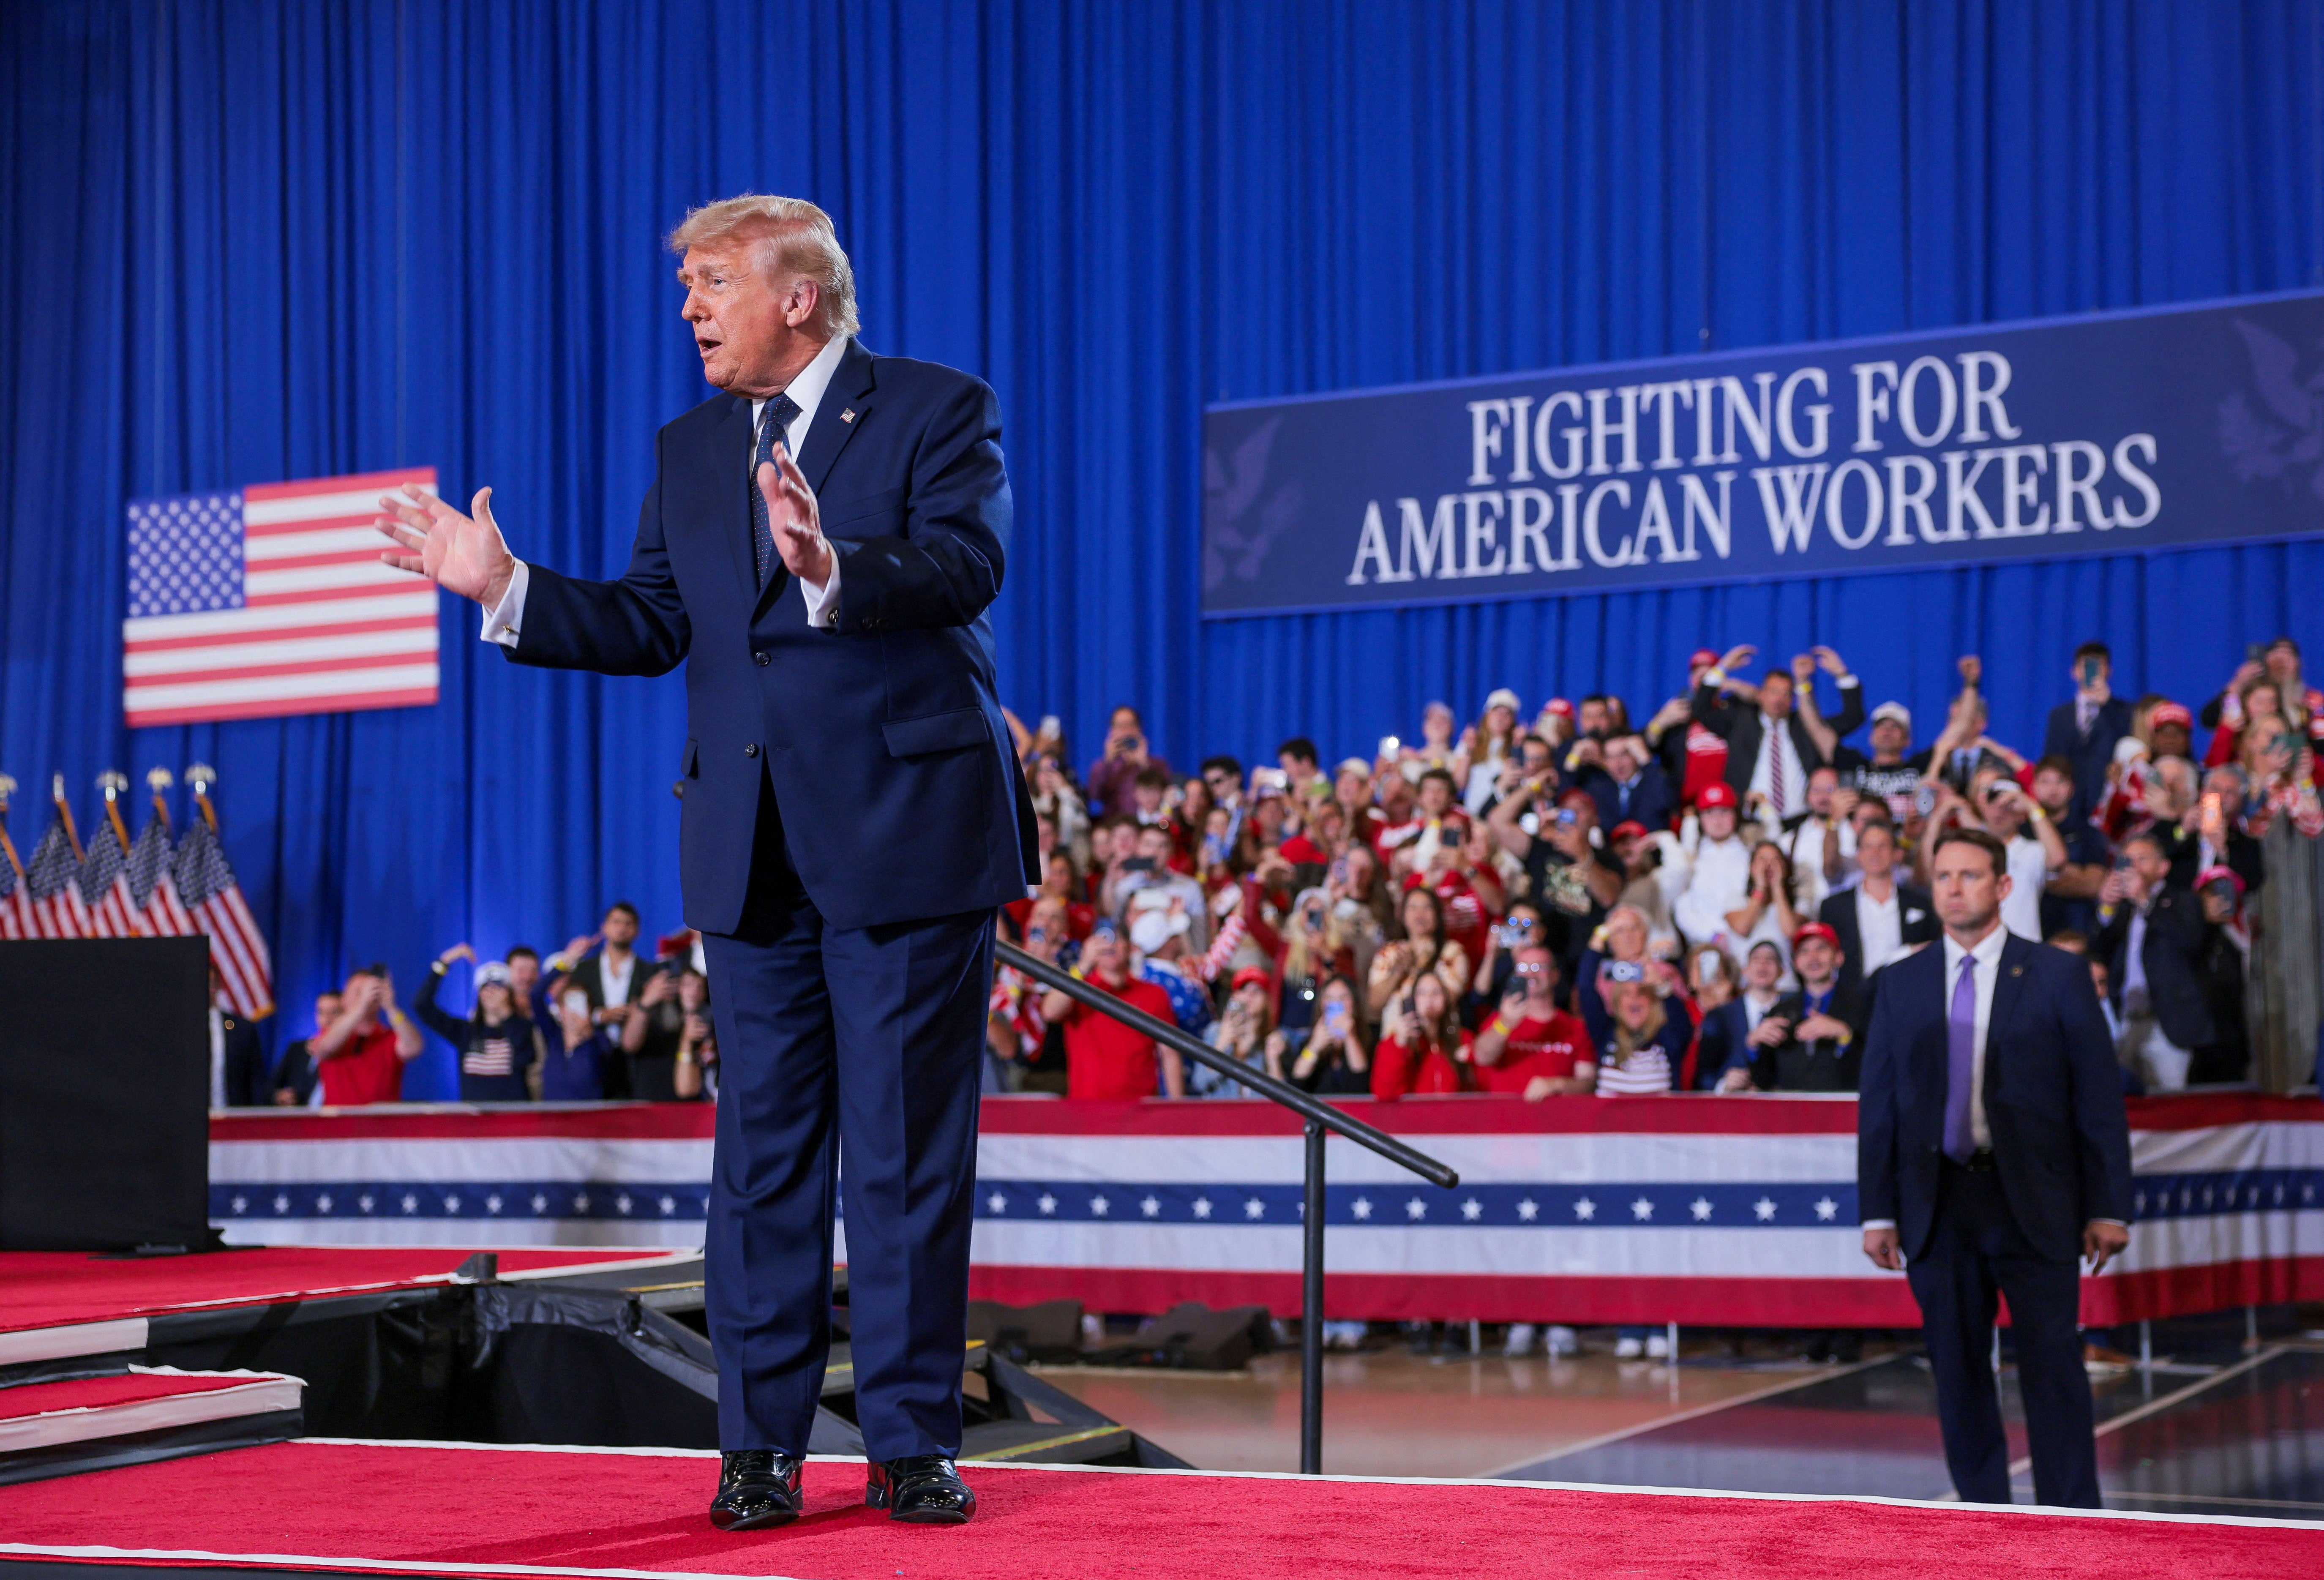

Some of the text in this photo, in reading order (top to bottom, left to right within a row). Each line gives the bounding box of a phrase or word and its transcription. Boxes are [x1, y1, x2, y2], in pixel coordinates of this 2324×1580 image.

[1468, 351, 2021, 486] FIGHTING FOR
[1347, 433, 2161, 585] AMERICAN WORKERS
